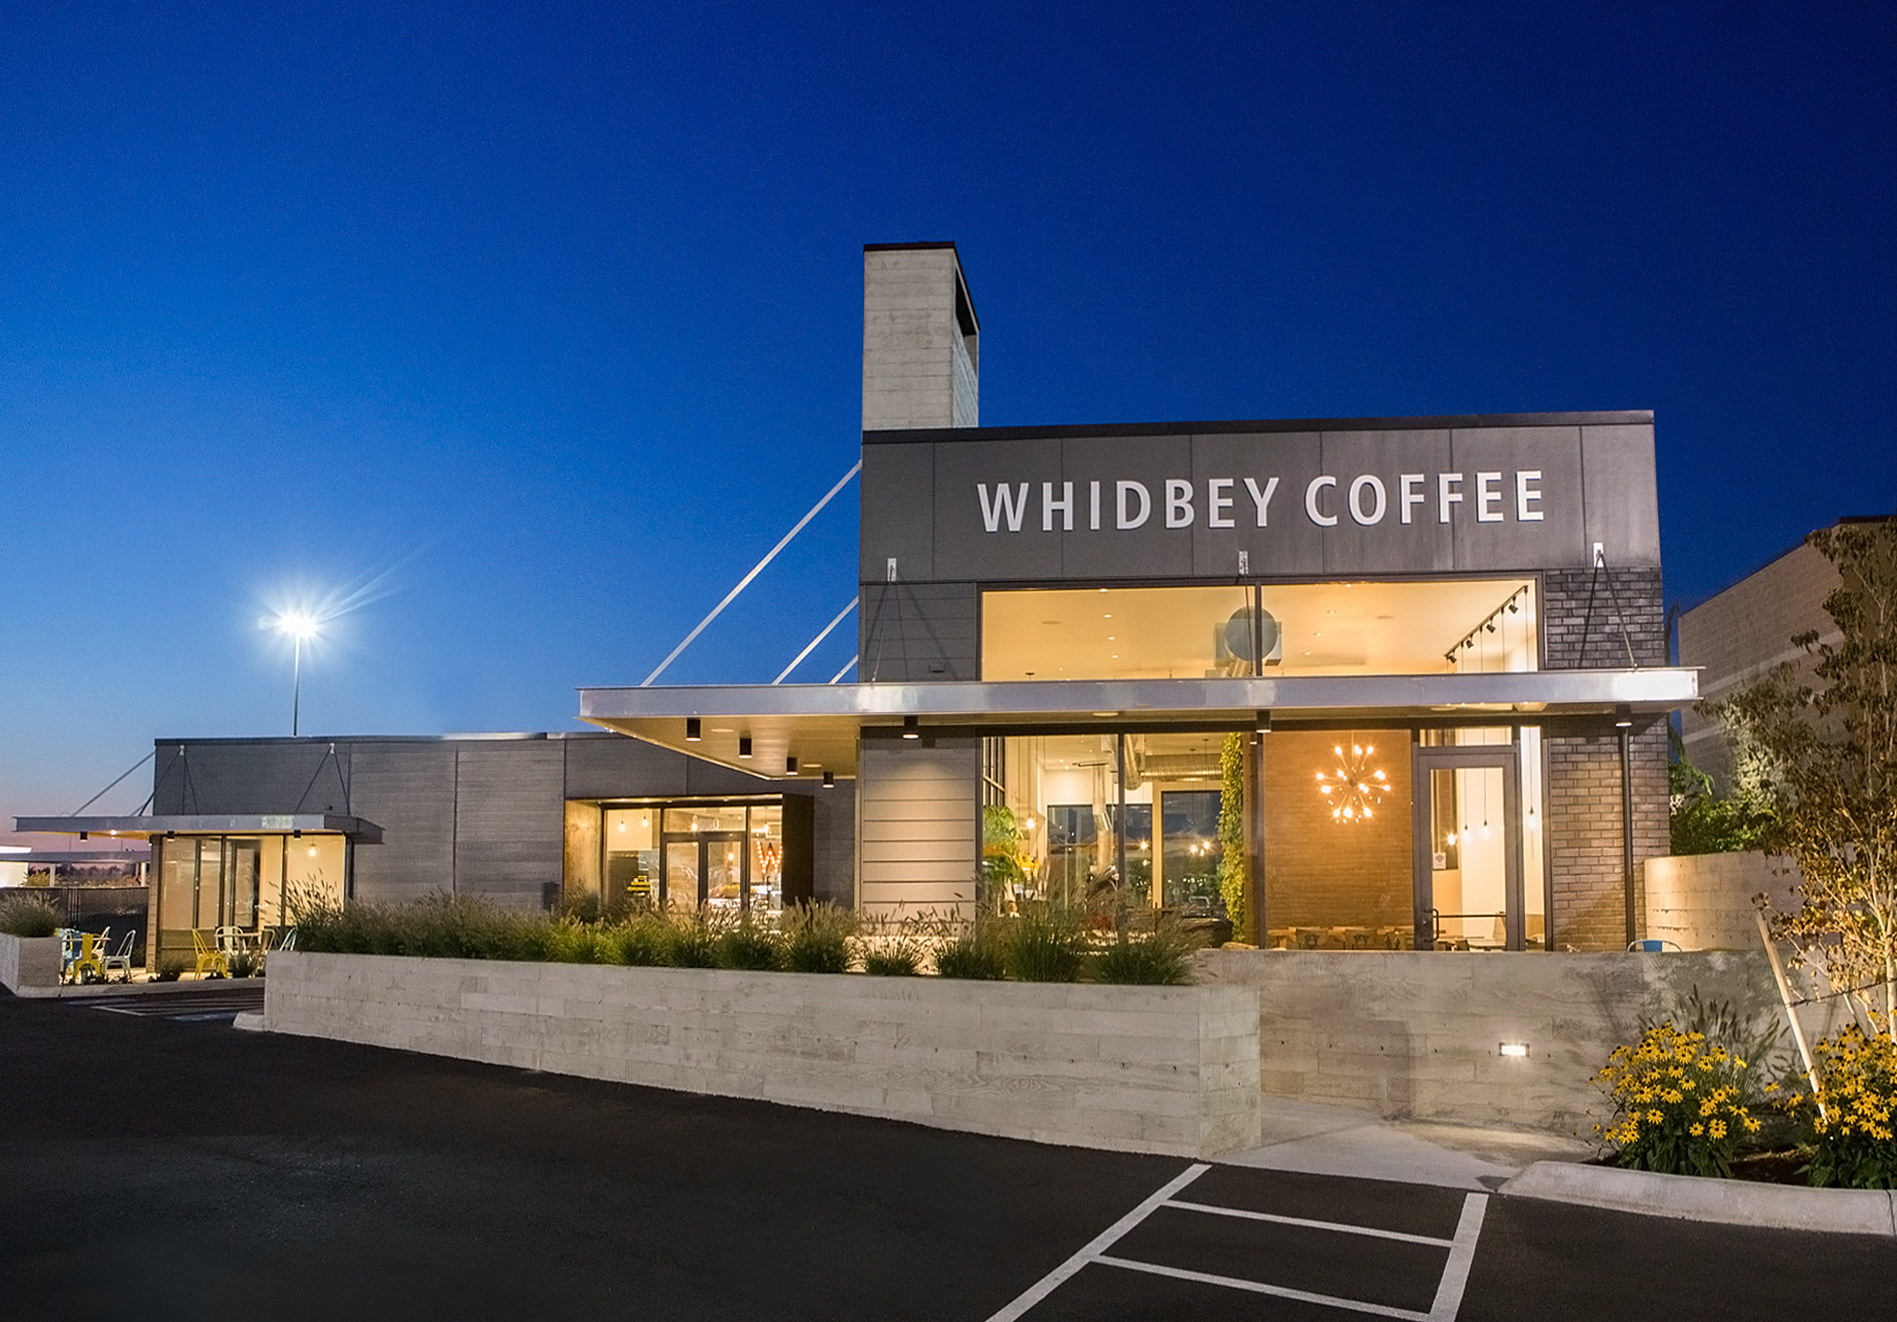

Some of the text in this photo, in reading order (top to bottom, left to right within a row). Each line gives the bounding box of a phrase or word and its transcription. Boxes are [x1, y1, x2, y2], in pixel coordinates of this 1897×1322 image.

[977, 470, 1545, 532] WHIDBEY COFFEE
[755, 840, 783, 874] W
